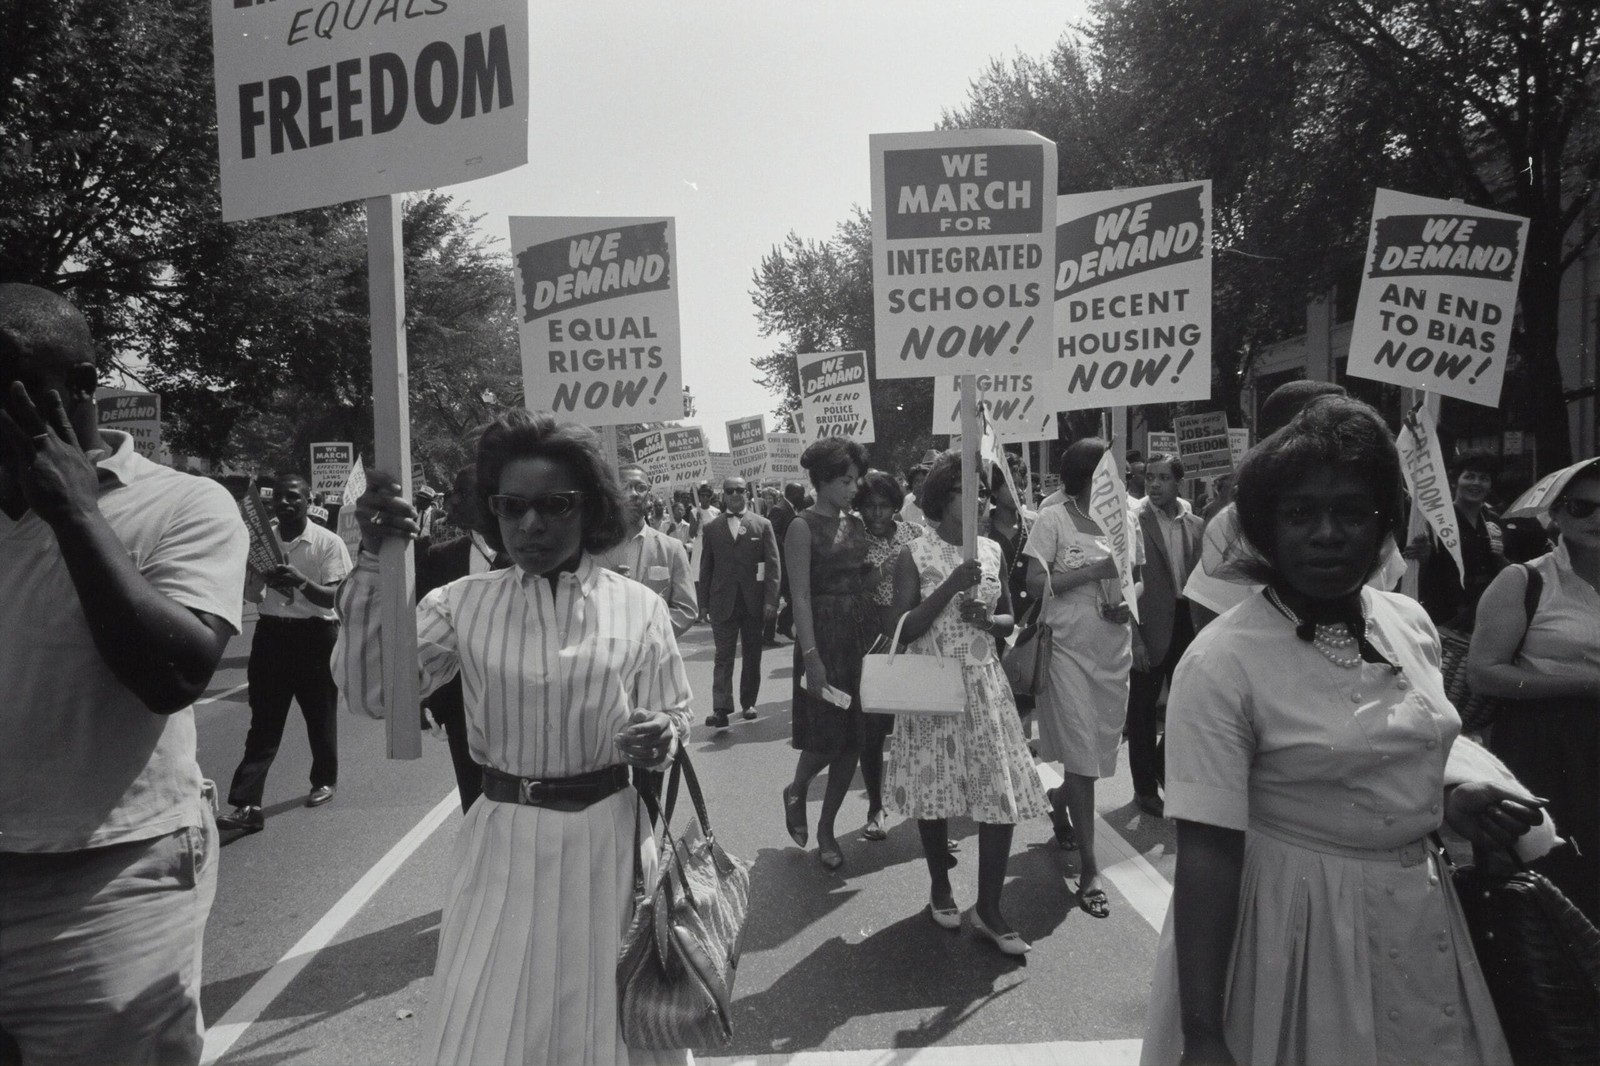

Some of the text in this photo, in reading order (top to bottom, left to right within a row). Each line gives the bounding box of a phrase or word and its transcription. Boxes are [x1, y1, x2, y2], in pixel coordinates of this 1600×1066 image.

[238, 24, 514, 160] FREEDOM
[941, 153, 988, 178] WE
[898, 180, 1031, 214] MARCH
[940, 216, 991, 232] FOR
[1094, 202, 1152, 245] WE
[1422, 218, 1477, 243] WE
[569, 232, 621, 268] WE
[887, 243, 1042, 276] INTEGRATED
[1055, 222, 1198, 291] DEMAND
[1380, 244, 1512, 272] DEMAND
[533, 254, 665, 311] DEMAND
[888, 282, 1041, 314] SCHOOLS
[1070, 289, 1189, 323] DECENT
[1379, 283, 1502, 326] AN END
[548, 316, 657, 342] EQUAL
[900, 315, 1035, 361] NOW!
[1380, 310, 1495, 353] TO BIAS
[1058, 324, 1201, 358] HOUSING
[549, 345, 663, 374] RIGHTS
[822, 357, 844, 374] WE
[1374, 340, 1492, 385] NOW!
[807, 366, 862, 393] DEMAND
[1068, 348, 1194, 394] NOW!
[552, 371, 668, 412] NOW!
[953, 375, 1033, 392] RGHTS
[116, 397, 138, 408] WE
[813, 392, 860, 403] AN END
[102, 406, 155, 421] DEMAND
[816, 413, 860, 424] BRUTALITY
[824, 405, 853, 415] POLICE
[1180, 415, 1221, 427] UAW SAYS
[646, 434, 660, 445] WE
[733, 428, 761, 441] MARCH
[817, 419, 867, 439] NOW!
[1180, 426, 1226, 440] JOBS and
[638, 442, 662, 458] DEMA
[668, 437, 700, 448] MARCH
[733, 444, 766, 458] FIRST CLASS
[1181, 438, 1229, 455] FREEDOM
[643, 455, 653, 464] AN
[669, 450, 706, 461] INTEGRATED
[671, 459, 707, 470] SCHOOLS
[733, 452, 768, 466] CITIZENSHIP
[1201, 459, 1230, 469] American
[676, 467, 707, 481] NOW!
[740, 462, 767, 477] NOW!
[1402, 421, 1457, 549] FREEDOM IN '63
[244, 495, 262, 529] MARCH
[311, 505, 328, 518] UA
[1091, 469, 1126, 556] FREEDOM
